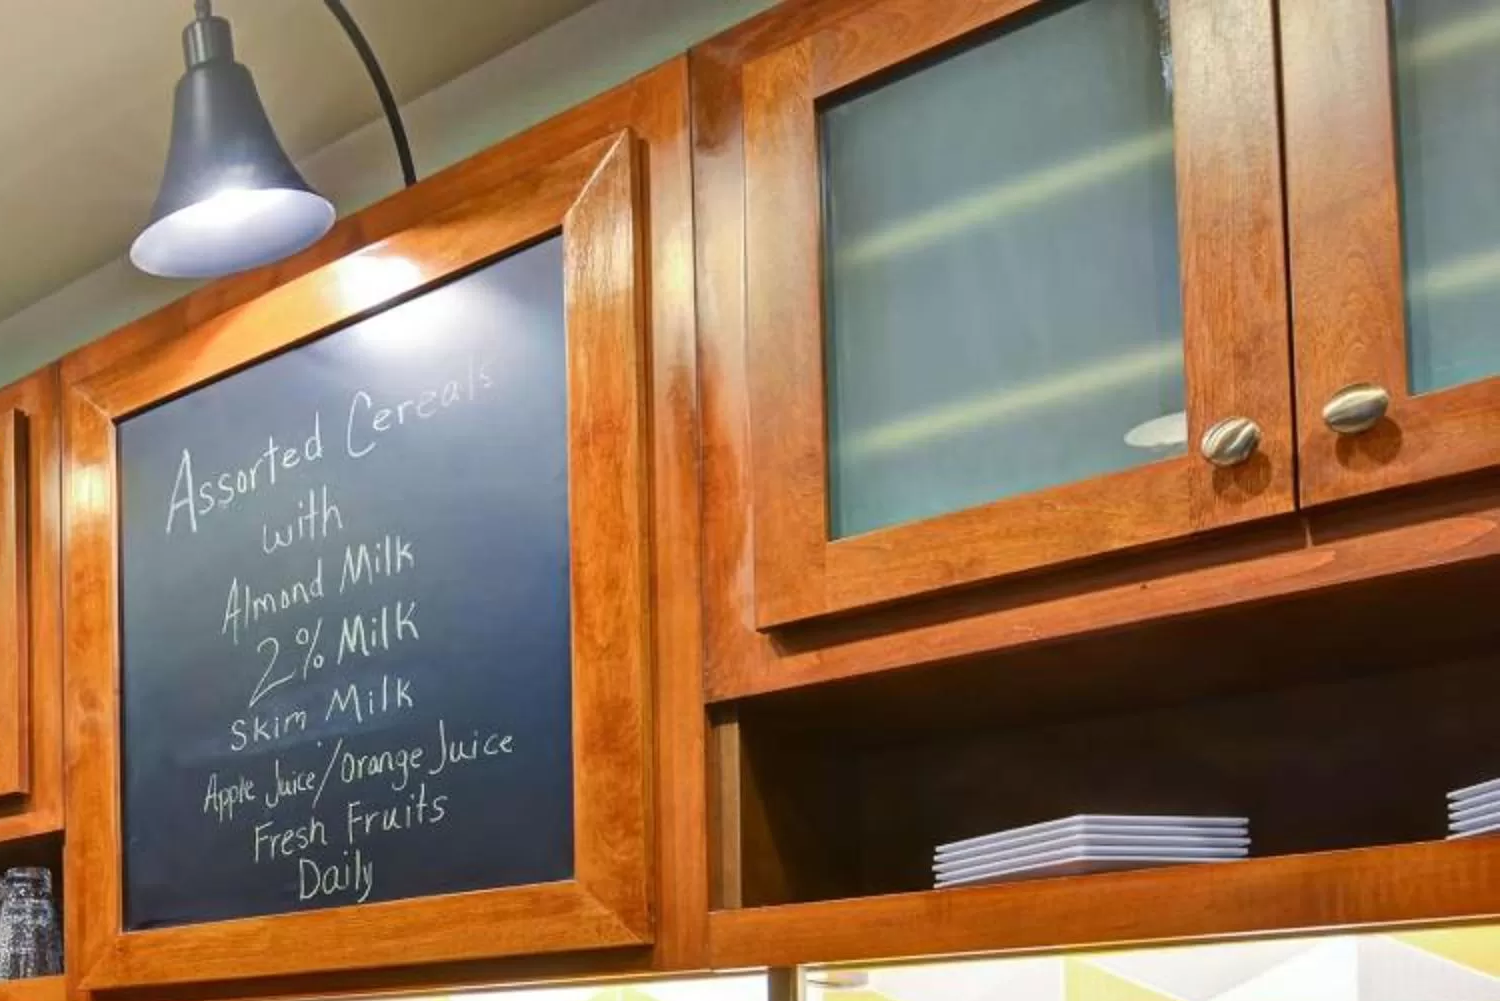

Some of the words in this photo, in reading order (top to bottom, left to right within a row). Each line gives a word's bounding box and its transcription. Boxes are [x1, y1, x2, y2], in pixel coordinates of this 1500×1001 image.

[166, 411, 323, 534] Assorted
[346, 362, 493, 457] Cereals
[263, 484, 343, 556] with
[222, 559, 324, 643] Almond
[339, 535, 415, 593] Milk
[337, 601, 420, 665] Milk
[325, 675, 414, 723] Milk
[204, 773, 256, 822] Apple
[427, 720, 514, 775] Juice
[254, 819, 328, 863] Fresh
[347, 784, 448, 844] Fruits
[298, 849, 374, 904] Daily
